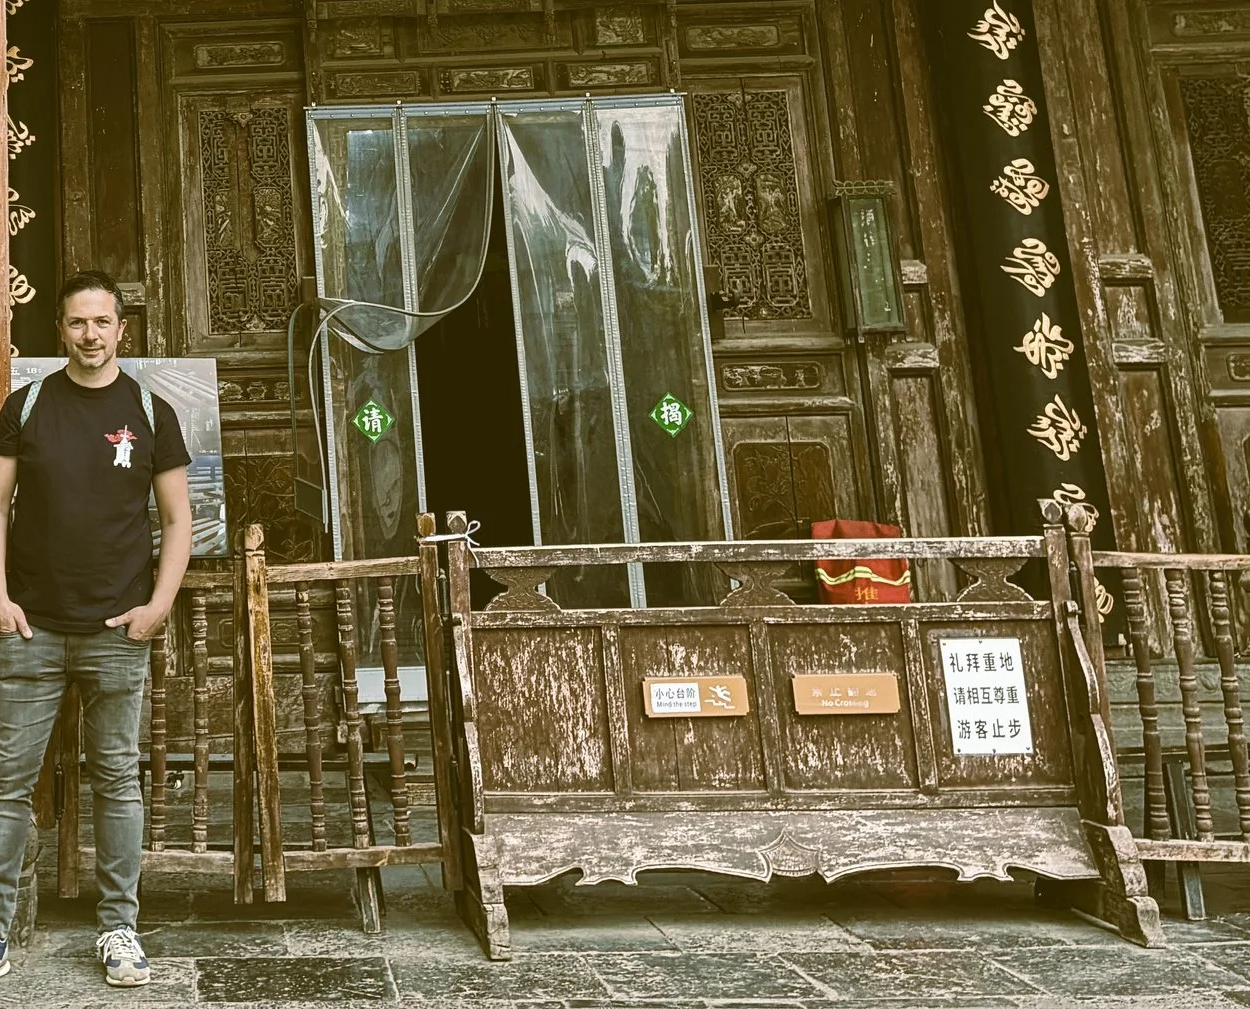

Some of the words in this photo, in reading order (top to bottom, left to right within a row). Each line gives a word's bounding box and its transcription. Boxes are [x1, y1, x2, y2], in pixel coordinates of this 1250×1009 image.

[361, 407, 384, 433] 请
[854, 586, 879, 604] 推
[949, 652, 1014, 673] 礼拜重地
[655, 687, 696, 700] 小心台阶
[953, 686, 1020, 705] 请相互尊重
[957, 718, 1022, 740] 游客止步
